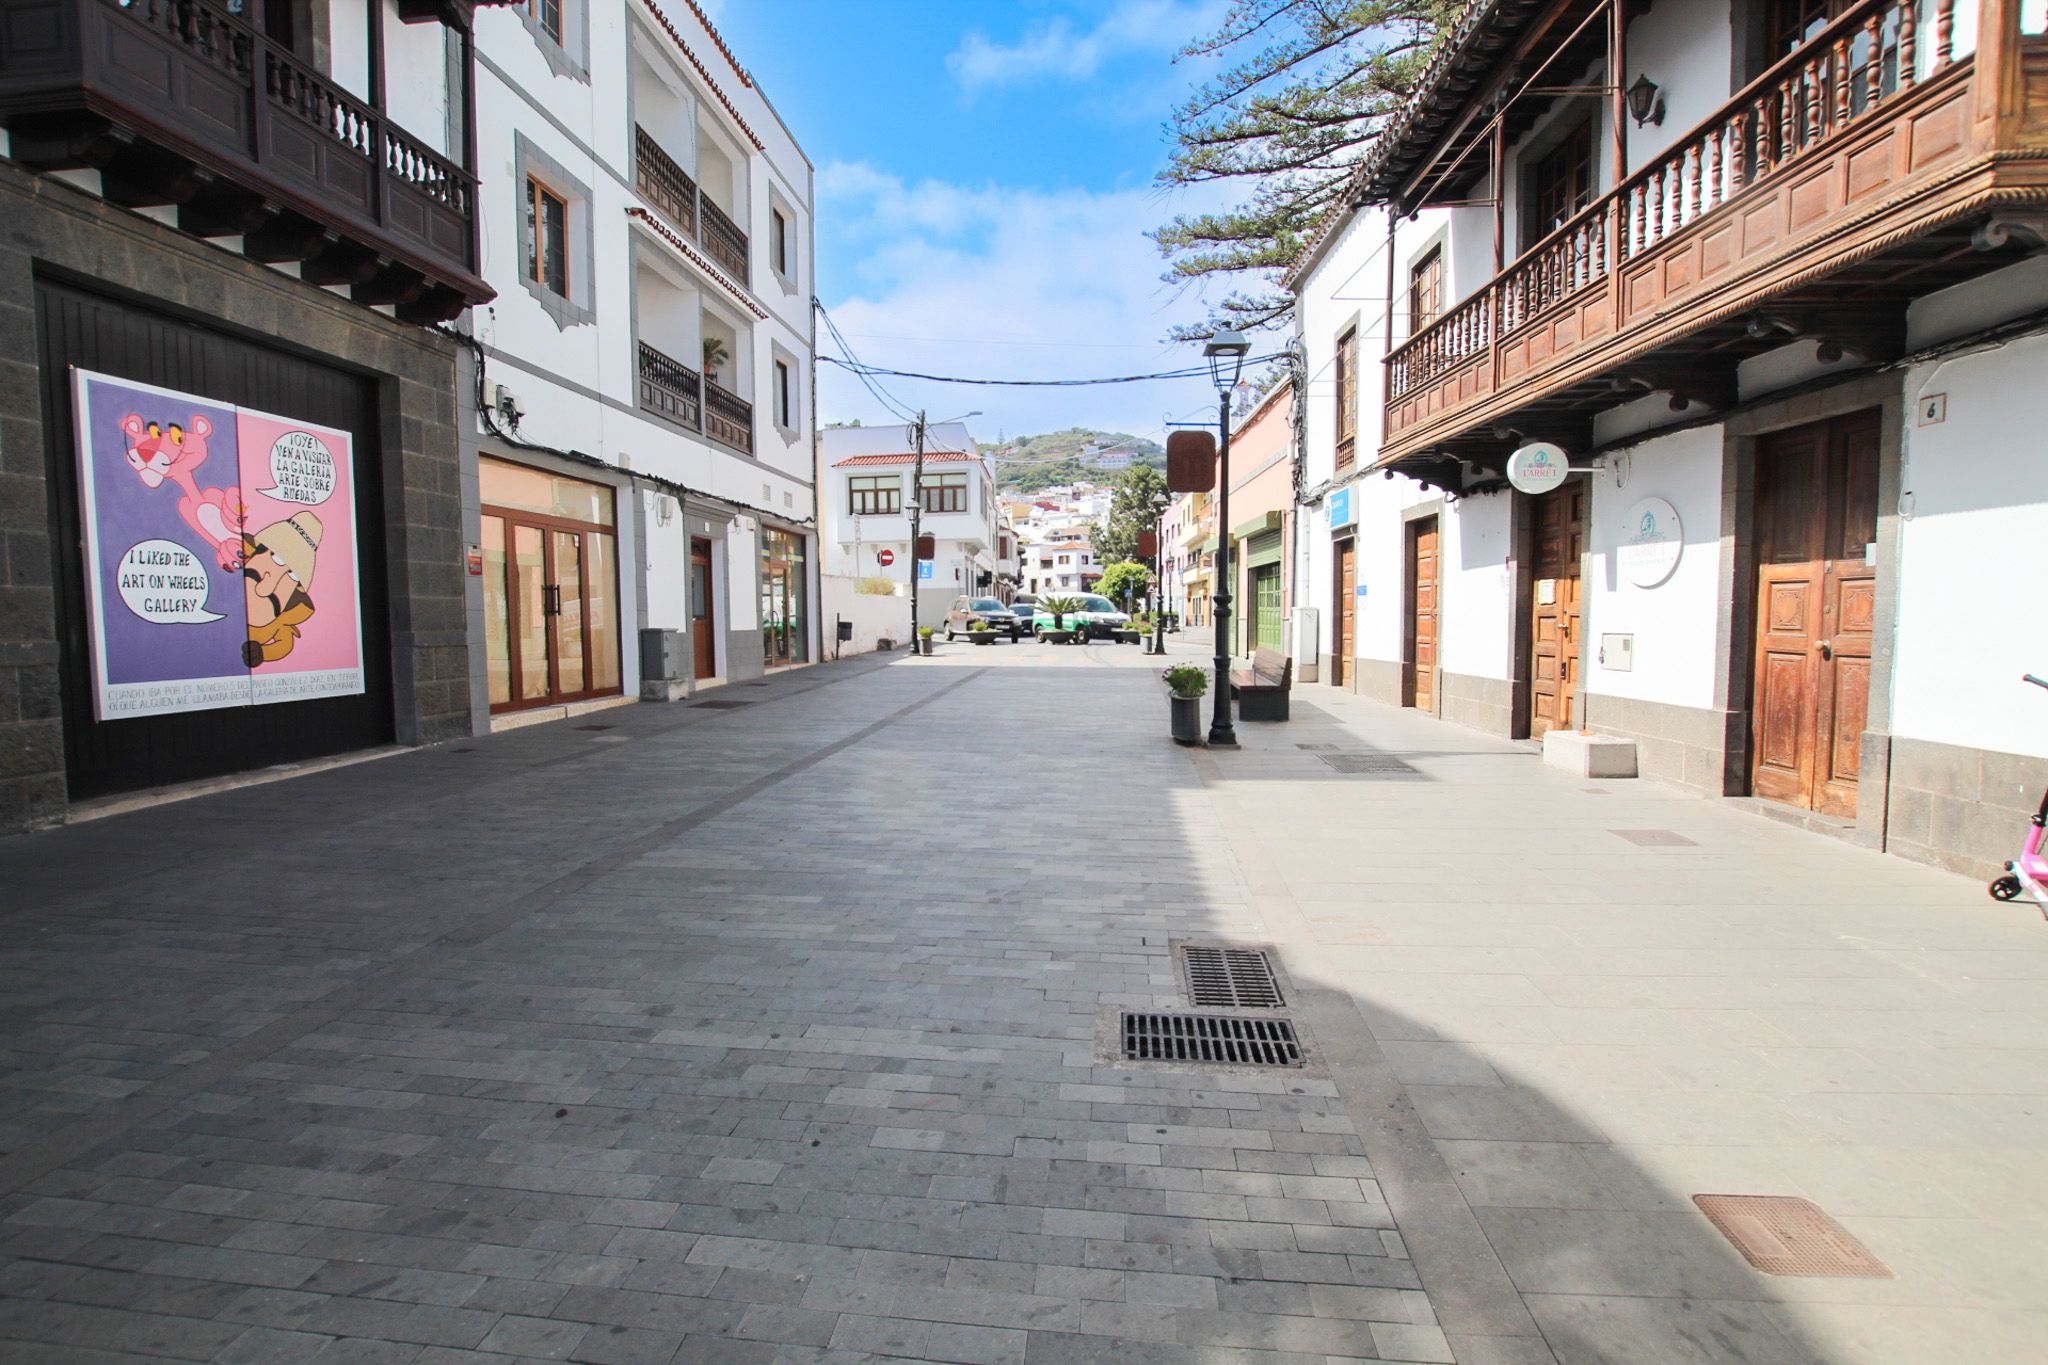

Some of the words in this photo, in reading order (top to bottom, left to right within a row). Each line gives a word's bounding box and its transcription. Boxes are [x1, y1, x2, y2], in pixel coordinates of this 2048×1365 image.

[1927, 402, 1935, 418] 6
[275, 444, 293, 459] VEN
[295, 449, 301, 460] A
[302, 449, 331, 466] VISITAR
[276, 459, 289, 472] LA
[279, 473, 300, 486] ARTE
[303, 477, 330, 492] SOBRE
[283, 486, 316, 503] RUEDAS
[129, 549, 134, 563] I
[139, 550, 172, 565] LIKED
[173, 552, 190, 566] THE
[122, 573, 146, 588] ART
[149, 574, 164, 589] ON
[167, 575, 206, 590] WHEELS
[144, 598, 197, 613] GALLERY
